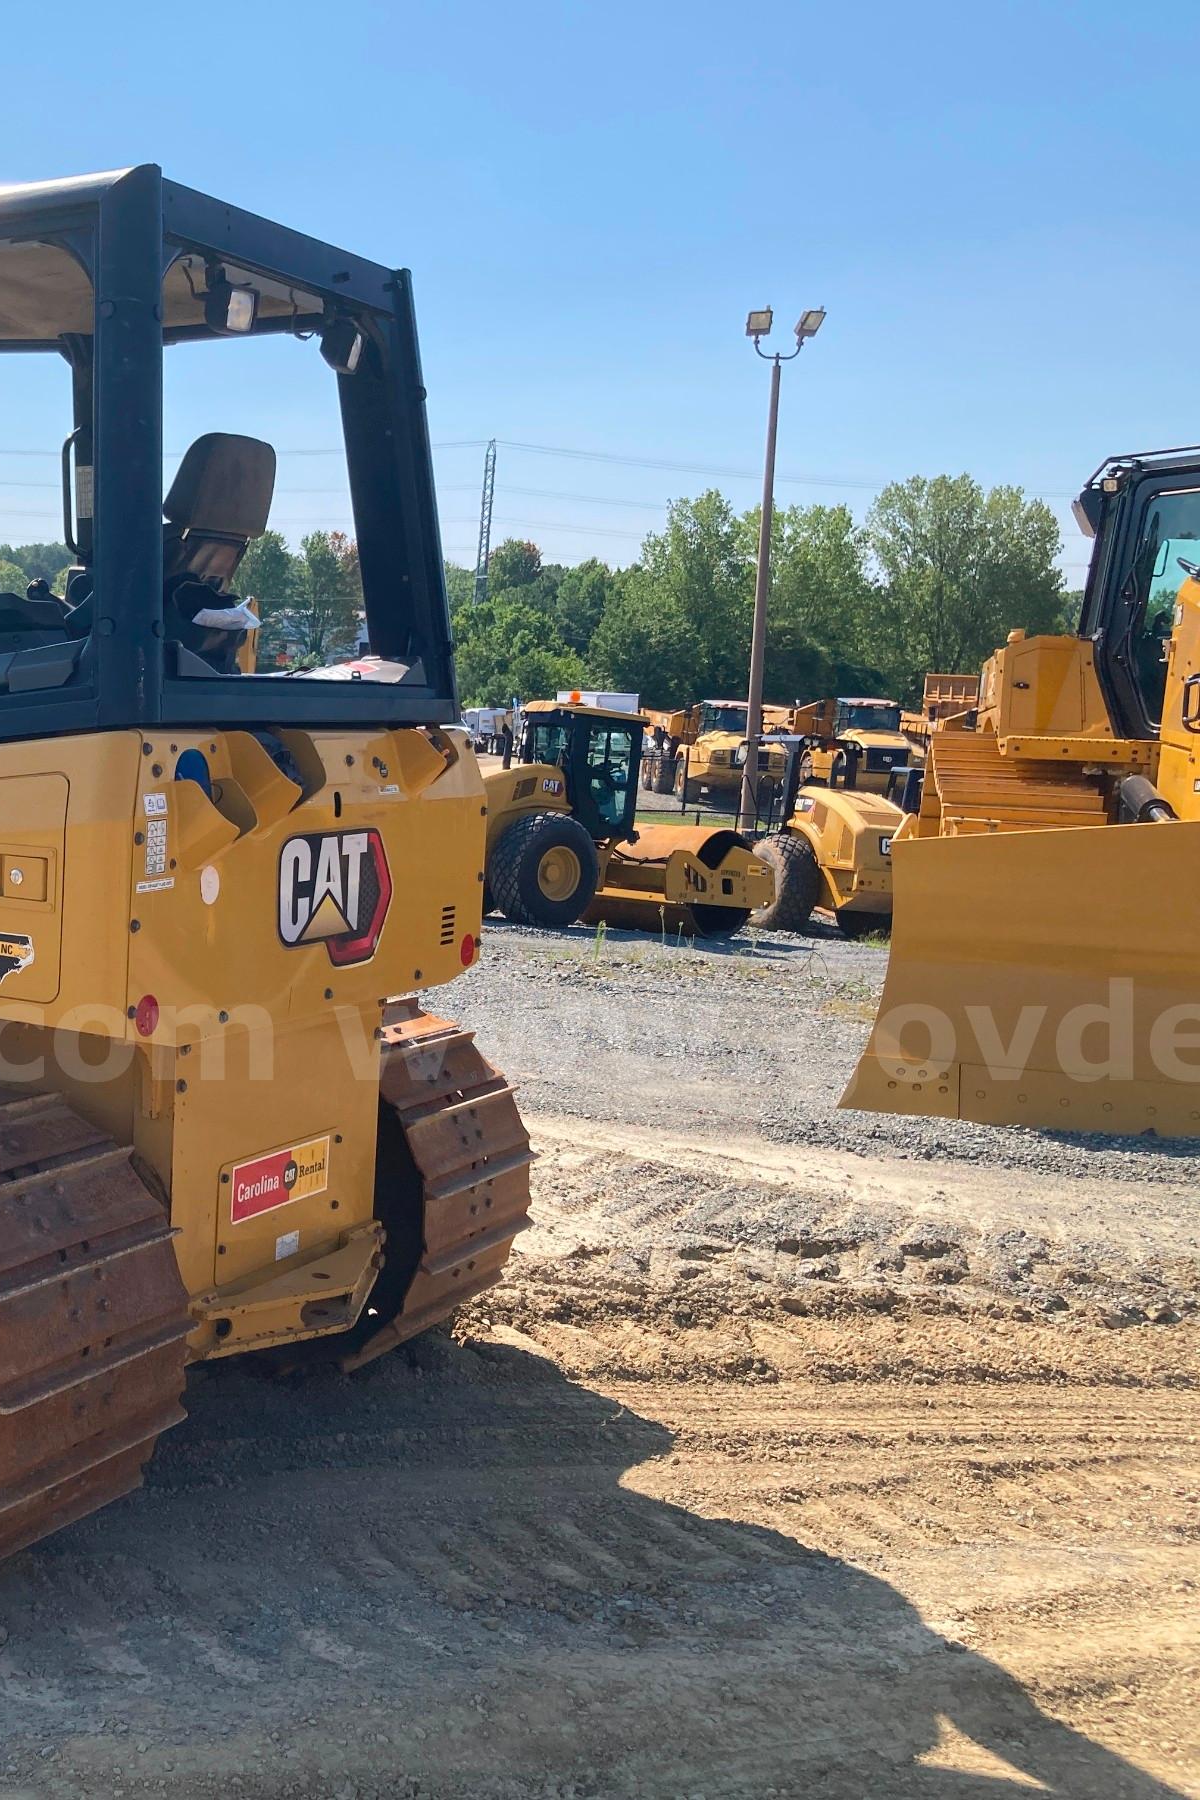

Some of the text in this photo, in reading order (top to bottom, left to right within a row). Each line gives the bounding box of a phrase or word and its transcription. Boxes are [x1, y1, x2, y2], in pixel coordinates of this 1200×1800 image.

[542, 779, 560, 793] CAT
[280, 832, 369, 943] CAT
[0, 943, 13, 955] NC
[237, 1158, 326, 1203] Carolina CAT Rental
